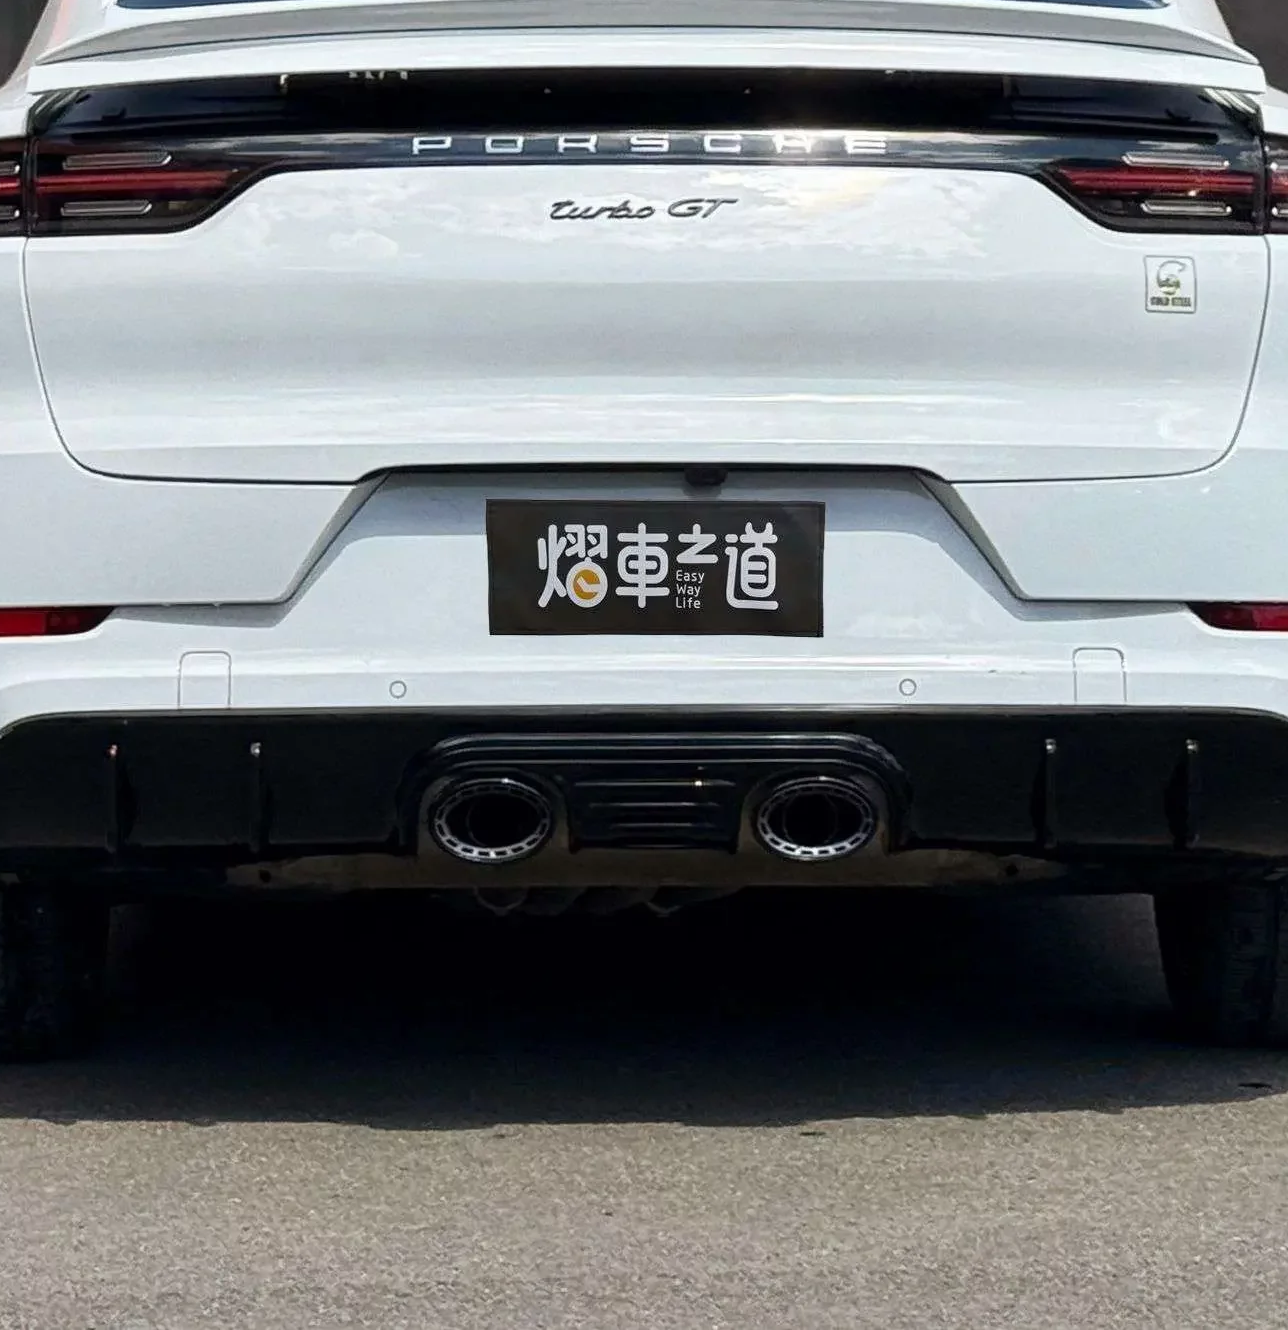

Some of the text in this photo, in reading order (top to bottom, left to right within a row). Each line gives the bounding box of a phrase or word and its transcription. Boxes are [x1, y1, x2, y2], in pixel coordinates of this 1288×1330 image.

[412, 133, 887, 155] PORSCHE
[549, 198, 738, 221] turbo GT
[675, 569, 705, 584] Easy
[676, 583, 701, 597] Way
[675, 596, 701, 609] Life
